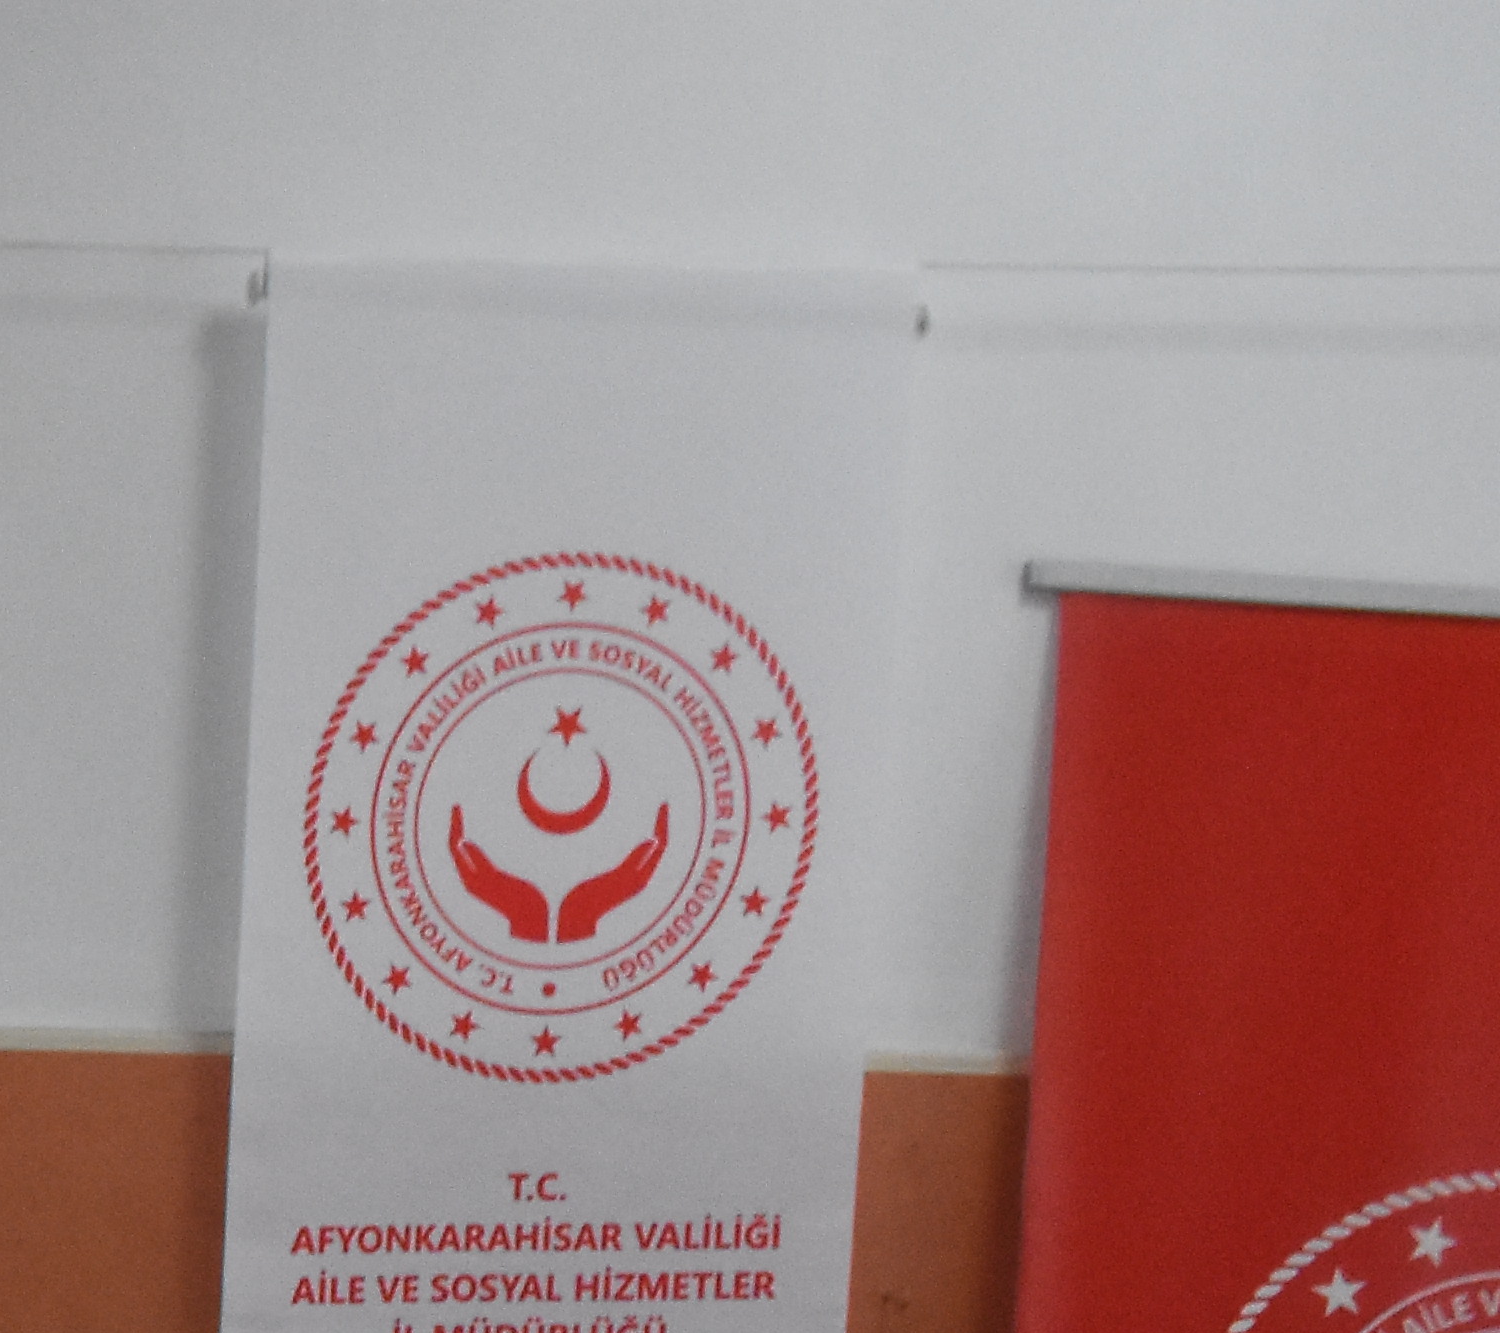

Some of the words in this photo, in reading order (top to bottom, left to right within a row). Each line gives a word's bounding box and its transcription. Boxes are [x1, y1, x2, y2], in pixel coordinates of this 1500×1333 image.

[492, 641, 543, 676] AİLE
[551, 639, 581, 659] VE
[589, 641, 672, 692] SOSYAL
[407, 665, 488, 753] VALİLİĞİ
[672, 686, 735, 821] HİZMETLER
[386, 759, 474, 973] AFYONKARAHİSAR
[602, 857, 726, 991] MÜDÜRLÜĞÜ
[508, 1172, 567, 1203] T.C.
[291, 1216, 622, 1257] AFYONKARAHİSAR
[636, 1212, 783, 1251] VALİLİĞİ
[291, 1269, 366, 1306] AİLE
[377, 1274, 420, 1305] VE
[430, 1271, 563, 1305] SOSYAL
[574, 1264, 776, 1303] HİZMETLER
